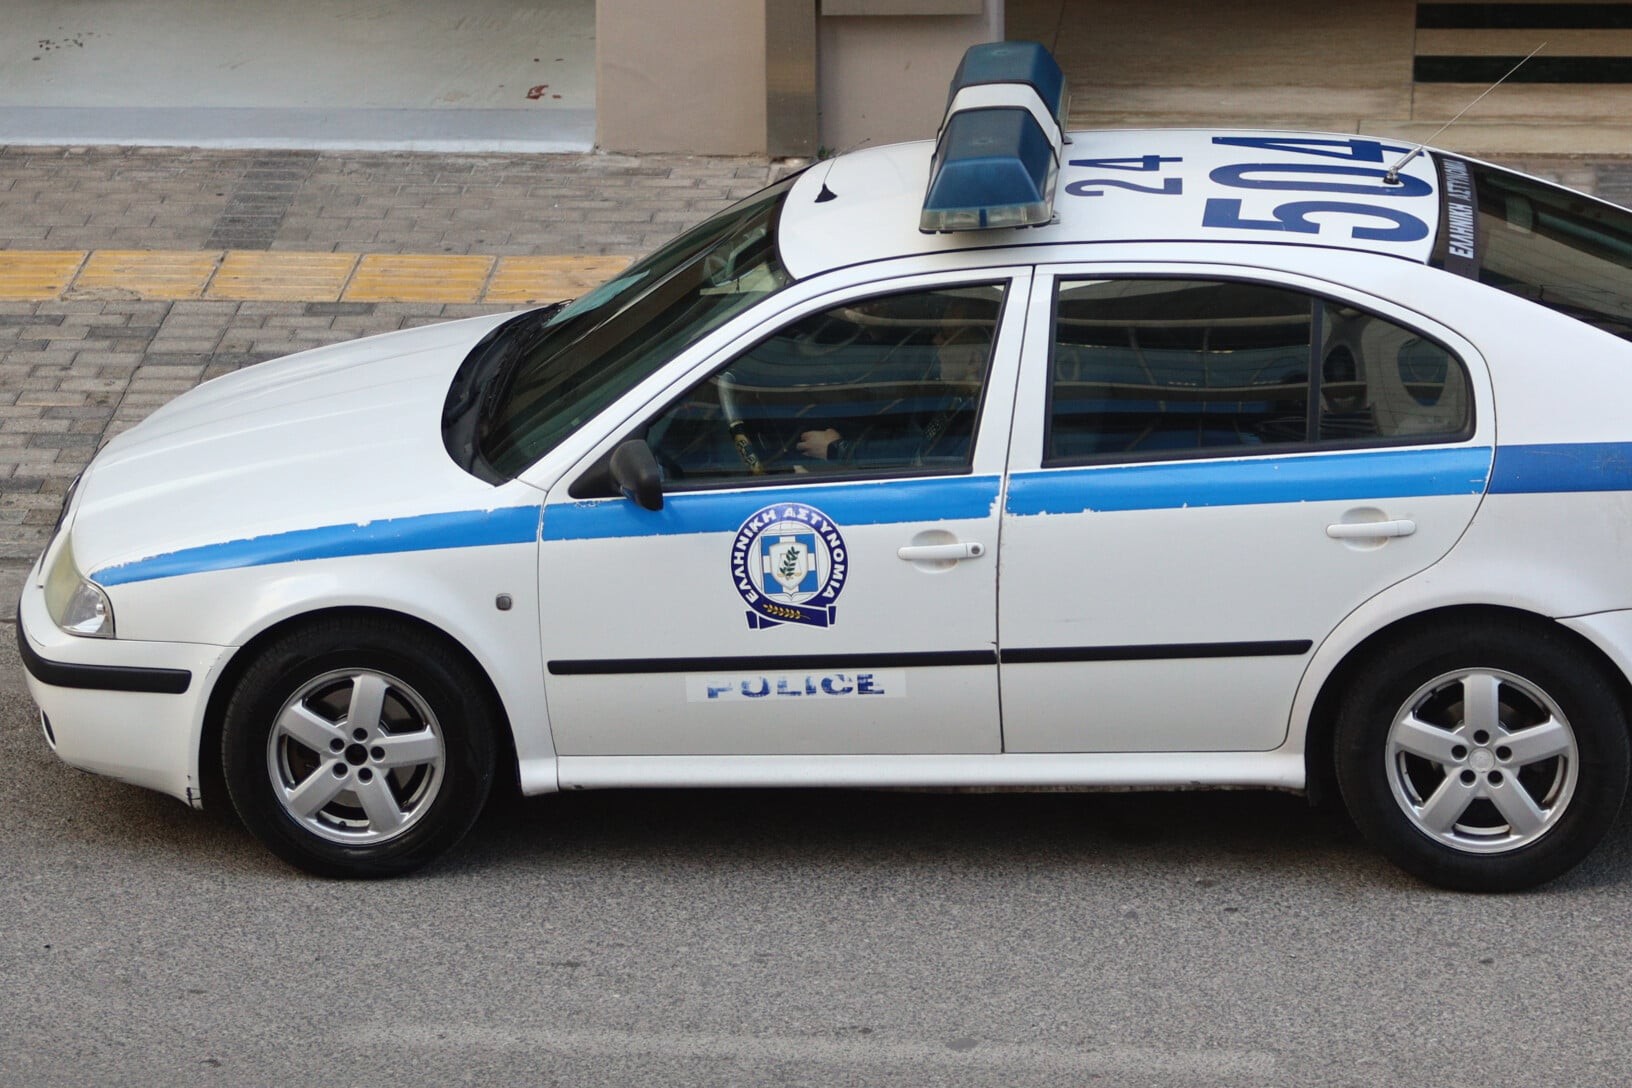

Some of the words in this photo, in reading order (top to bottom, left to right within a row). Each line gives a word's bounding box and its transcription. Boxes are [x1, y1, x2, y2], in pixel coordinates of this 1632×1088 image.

[1065, 155, 1182, 196] 24
[1202, 136, 1433, 242] 504
[1448, 203, 1474, 259] ΕΛΛΗΝΙΚΗ
[733, 508, 776, 603] ΕΛΛΗΝΙΚΗ
[784, 507, 845, 599] ΑΣΤΥΝΟΜΙΑ
